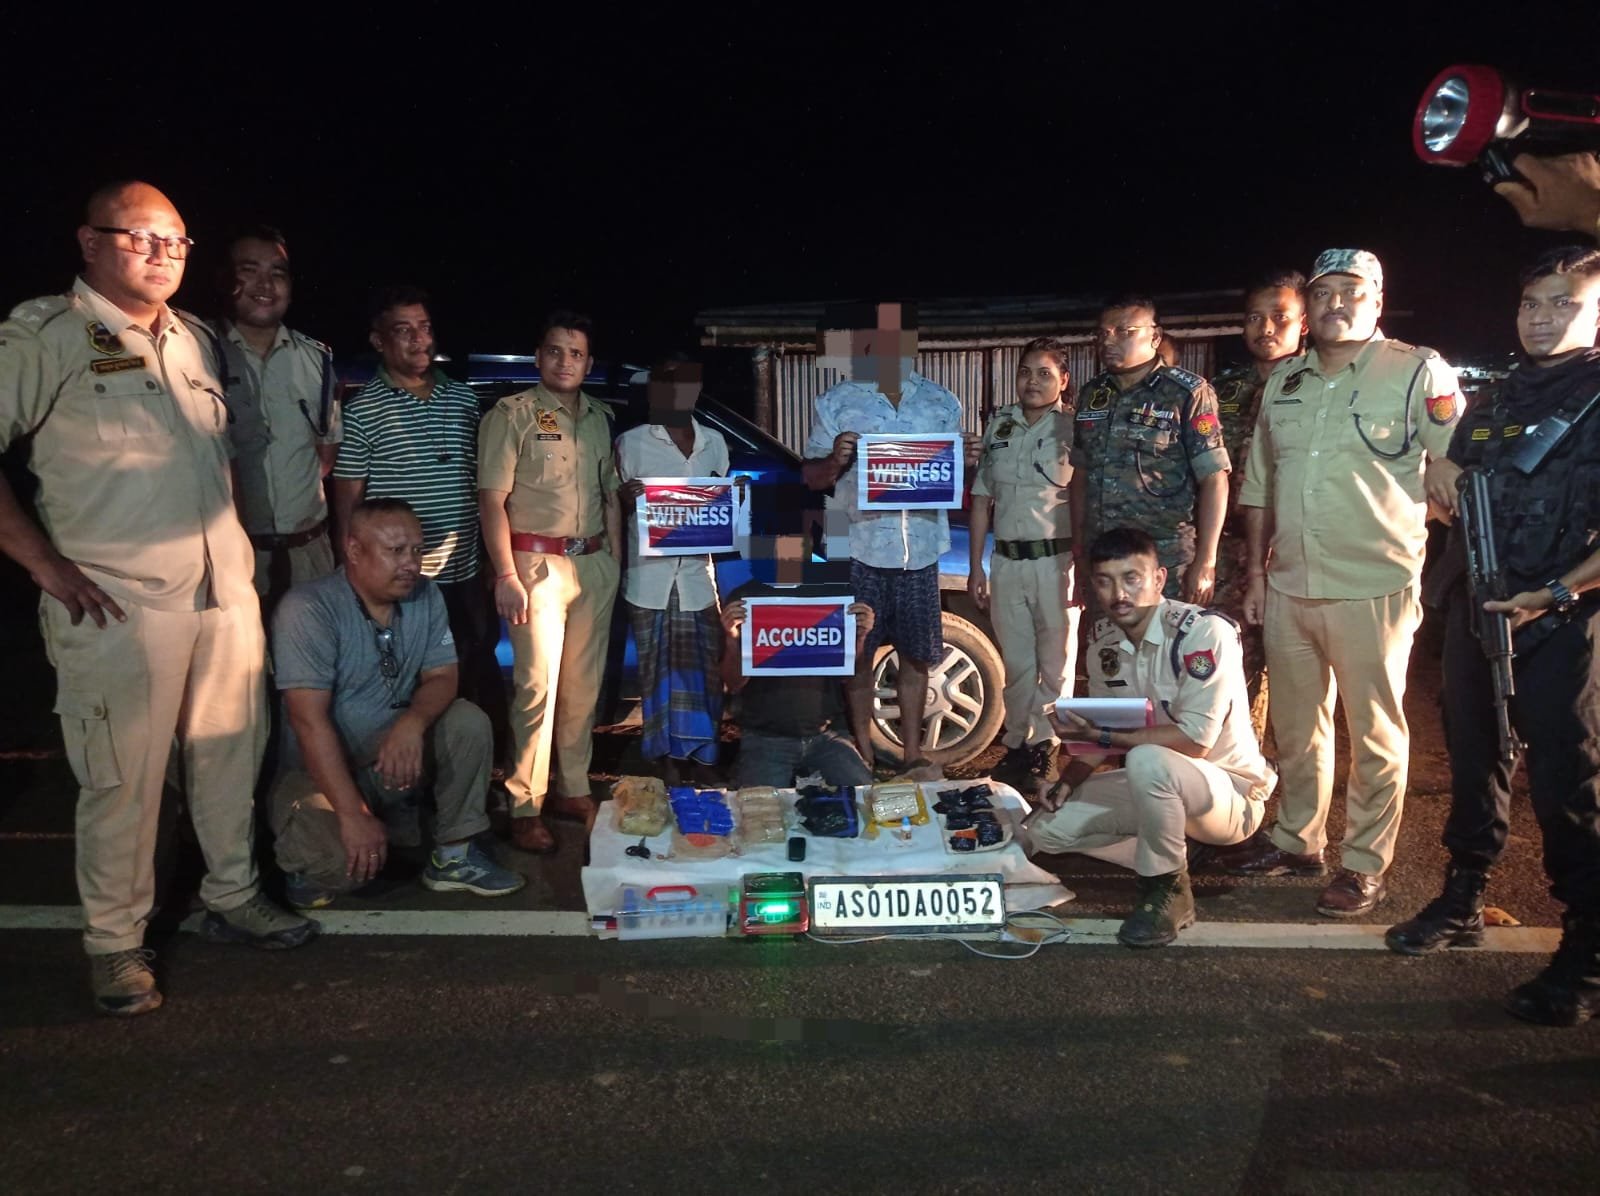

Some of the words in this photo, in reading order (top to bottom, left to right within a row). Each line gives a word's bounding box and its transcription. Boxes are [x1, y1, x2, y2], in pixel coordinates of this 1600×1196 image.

[872, 462, 951, 483] WITNESS
[649, 506, 729, 526] WITNESS
[756, 627, 842, 647] ACCUSED
[817, 901, 832, 910] IND
[835, 887, 995, 918] AS01DA0052
